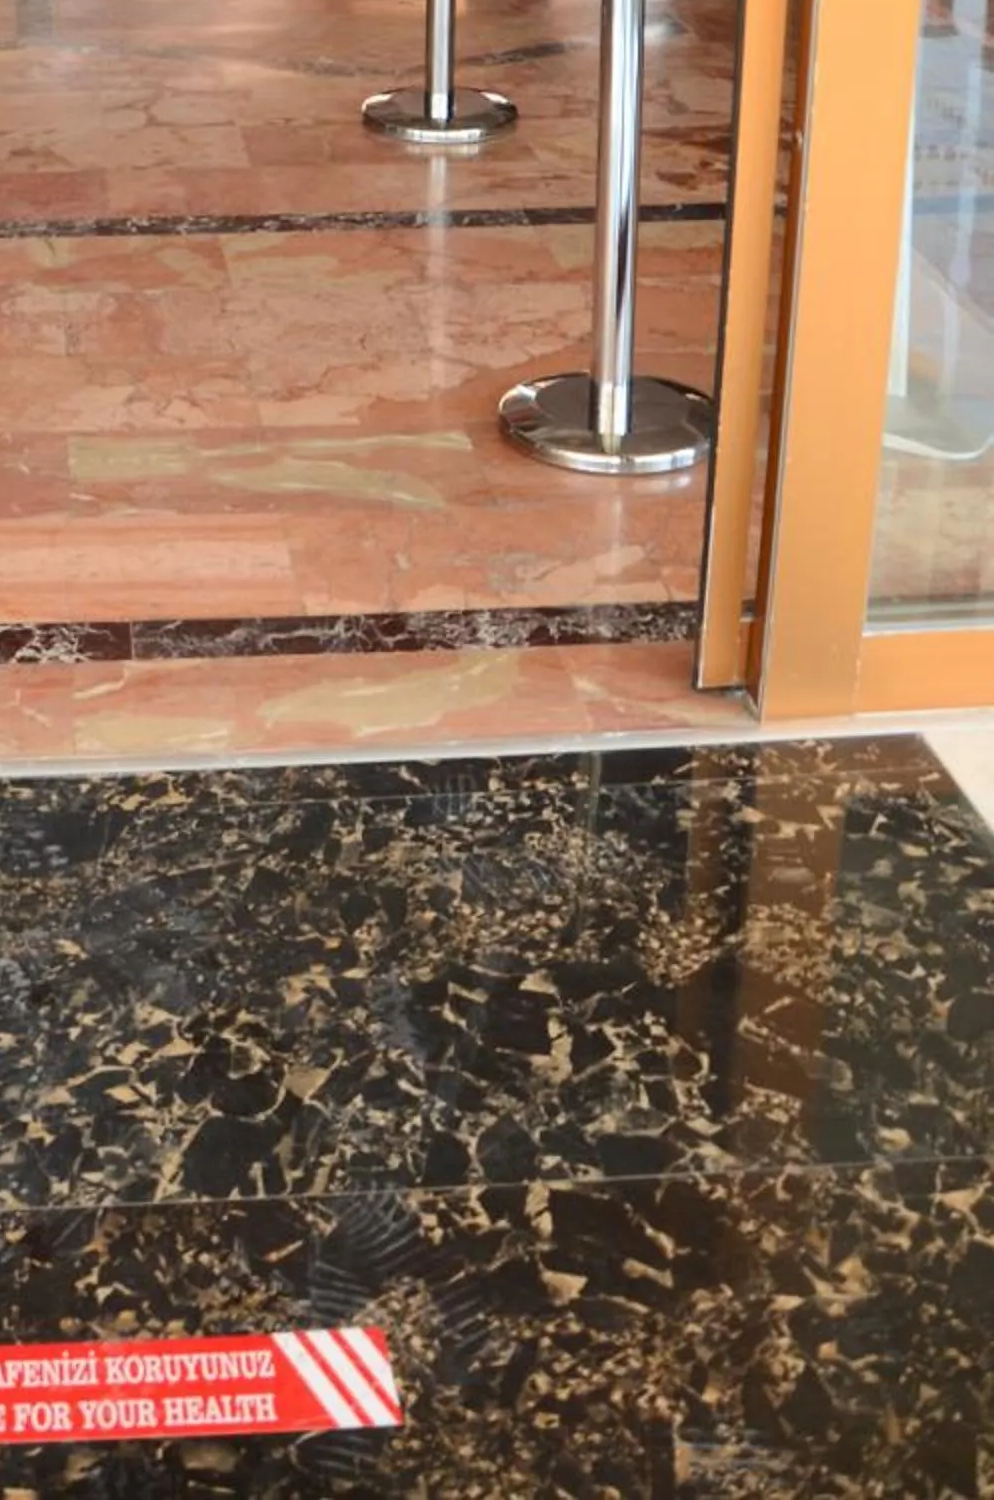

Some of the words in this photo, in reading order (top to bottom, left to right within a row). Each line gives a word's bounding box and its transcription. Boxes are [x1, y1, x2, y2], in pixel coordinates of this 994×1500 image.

[104, 1350, 275, 1383] KORUYUNUZ
[13, 1400, 72, 1432] FOR
[78, 1397, 160, 1430] YOUR
[165, 1393, 277, 1427] HEALTH
